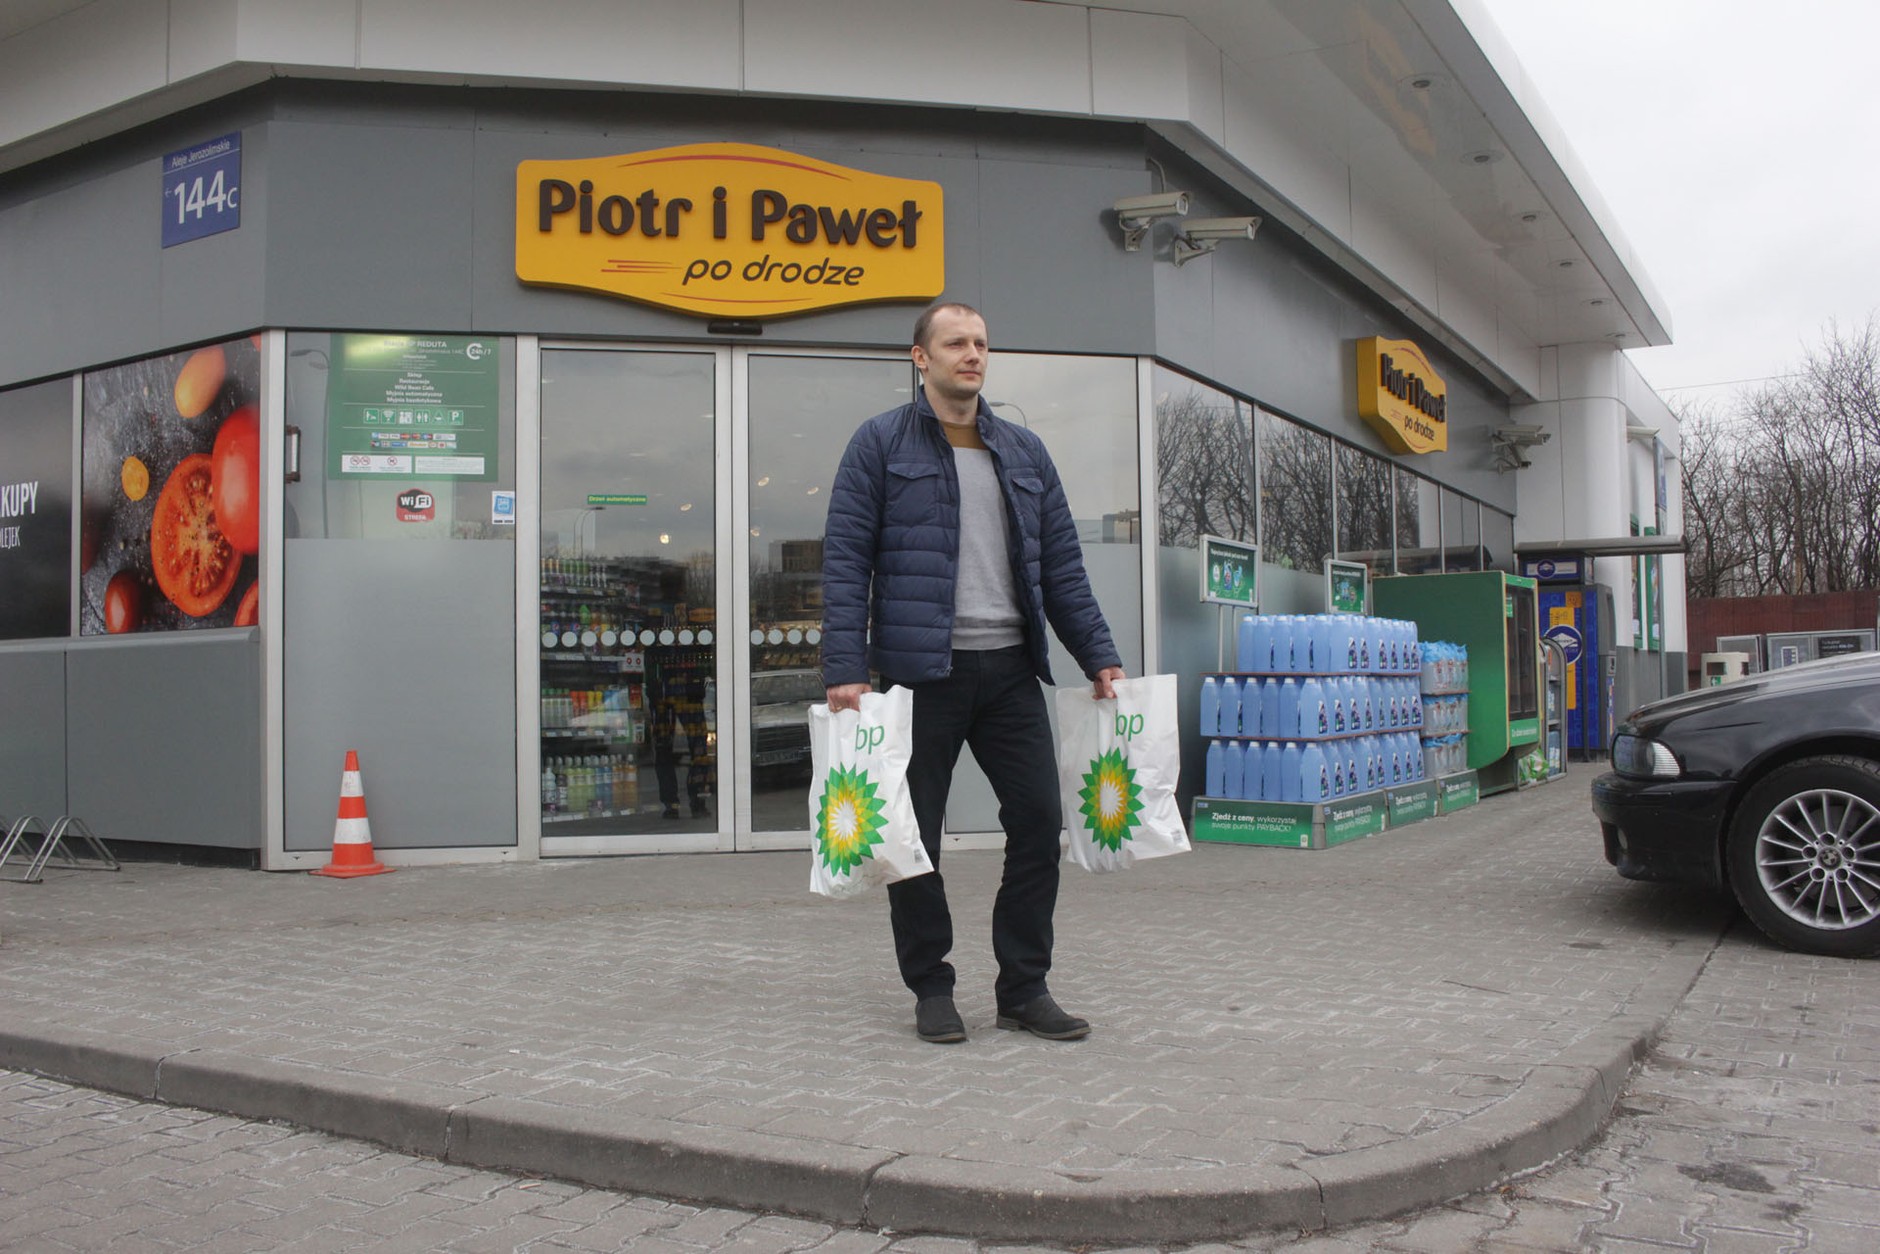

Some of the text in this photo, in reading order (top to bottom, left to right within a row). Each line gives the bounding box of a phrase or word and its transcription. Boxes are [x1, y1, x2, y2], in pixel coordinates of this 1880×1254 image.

[171, 139, 231, 168] Aleje Jerozolimskie
[538, 179, 923, 248] Piotr i Paweł
[682, 254, 865, 286] po drodze
[417, 340, 447, 348] REDUTA
[1404, 415, 1435, 441] po drodze
[0, 481, 38, 518] KUPY
[854, 724, 885, 755] bp
[1115, 709, 1145, 742] bp
[1232, 823, 1255, 832] punkty
